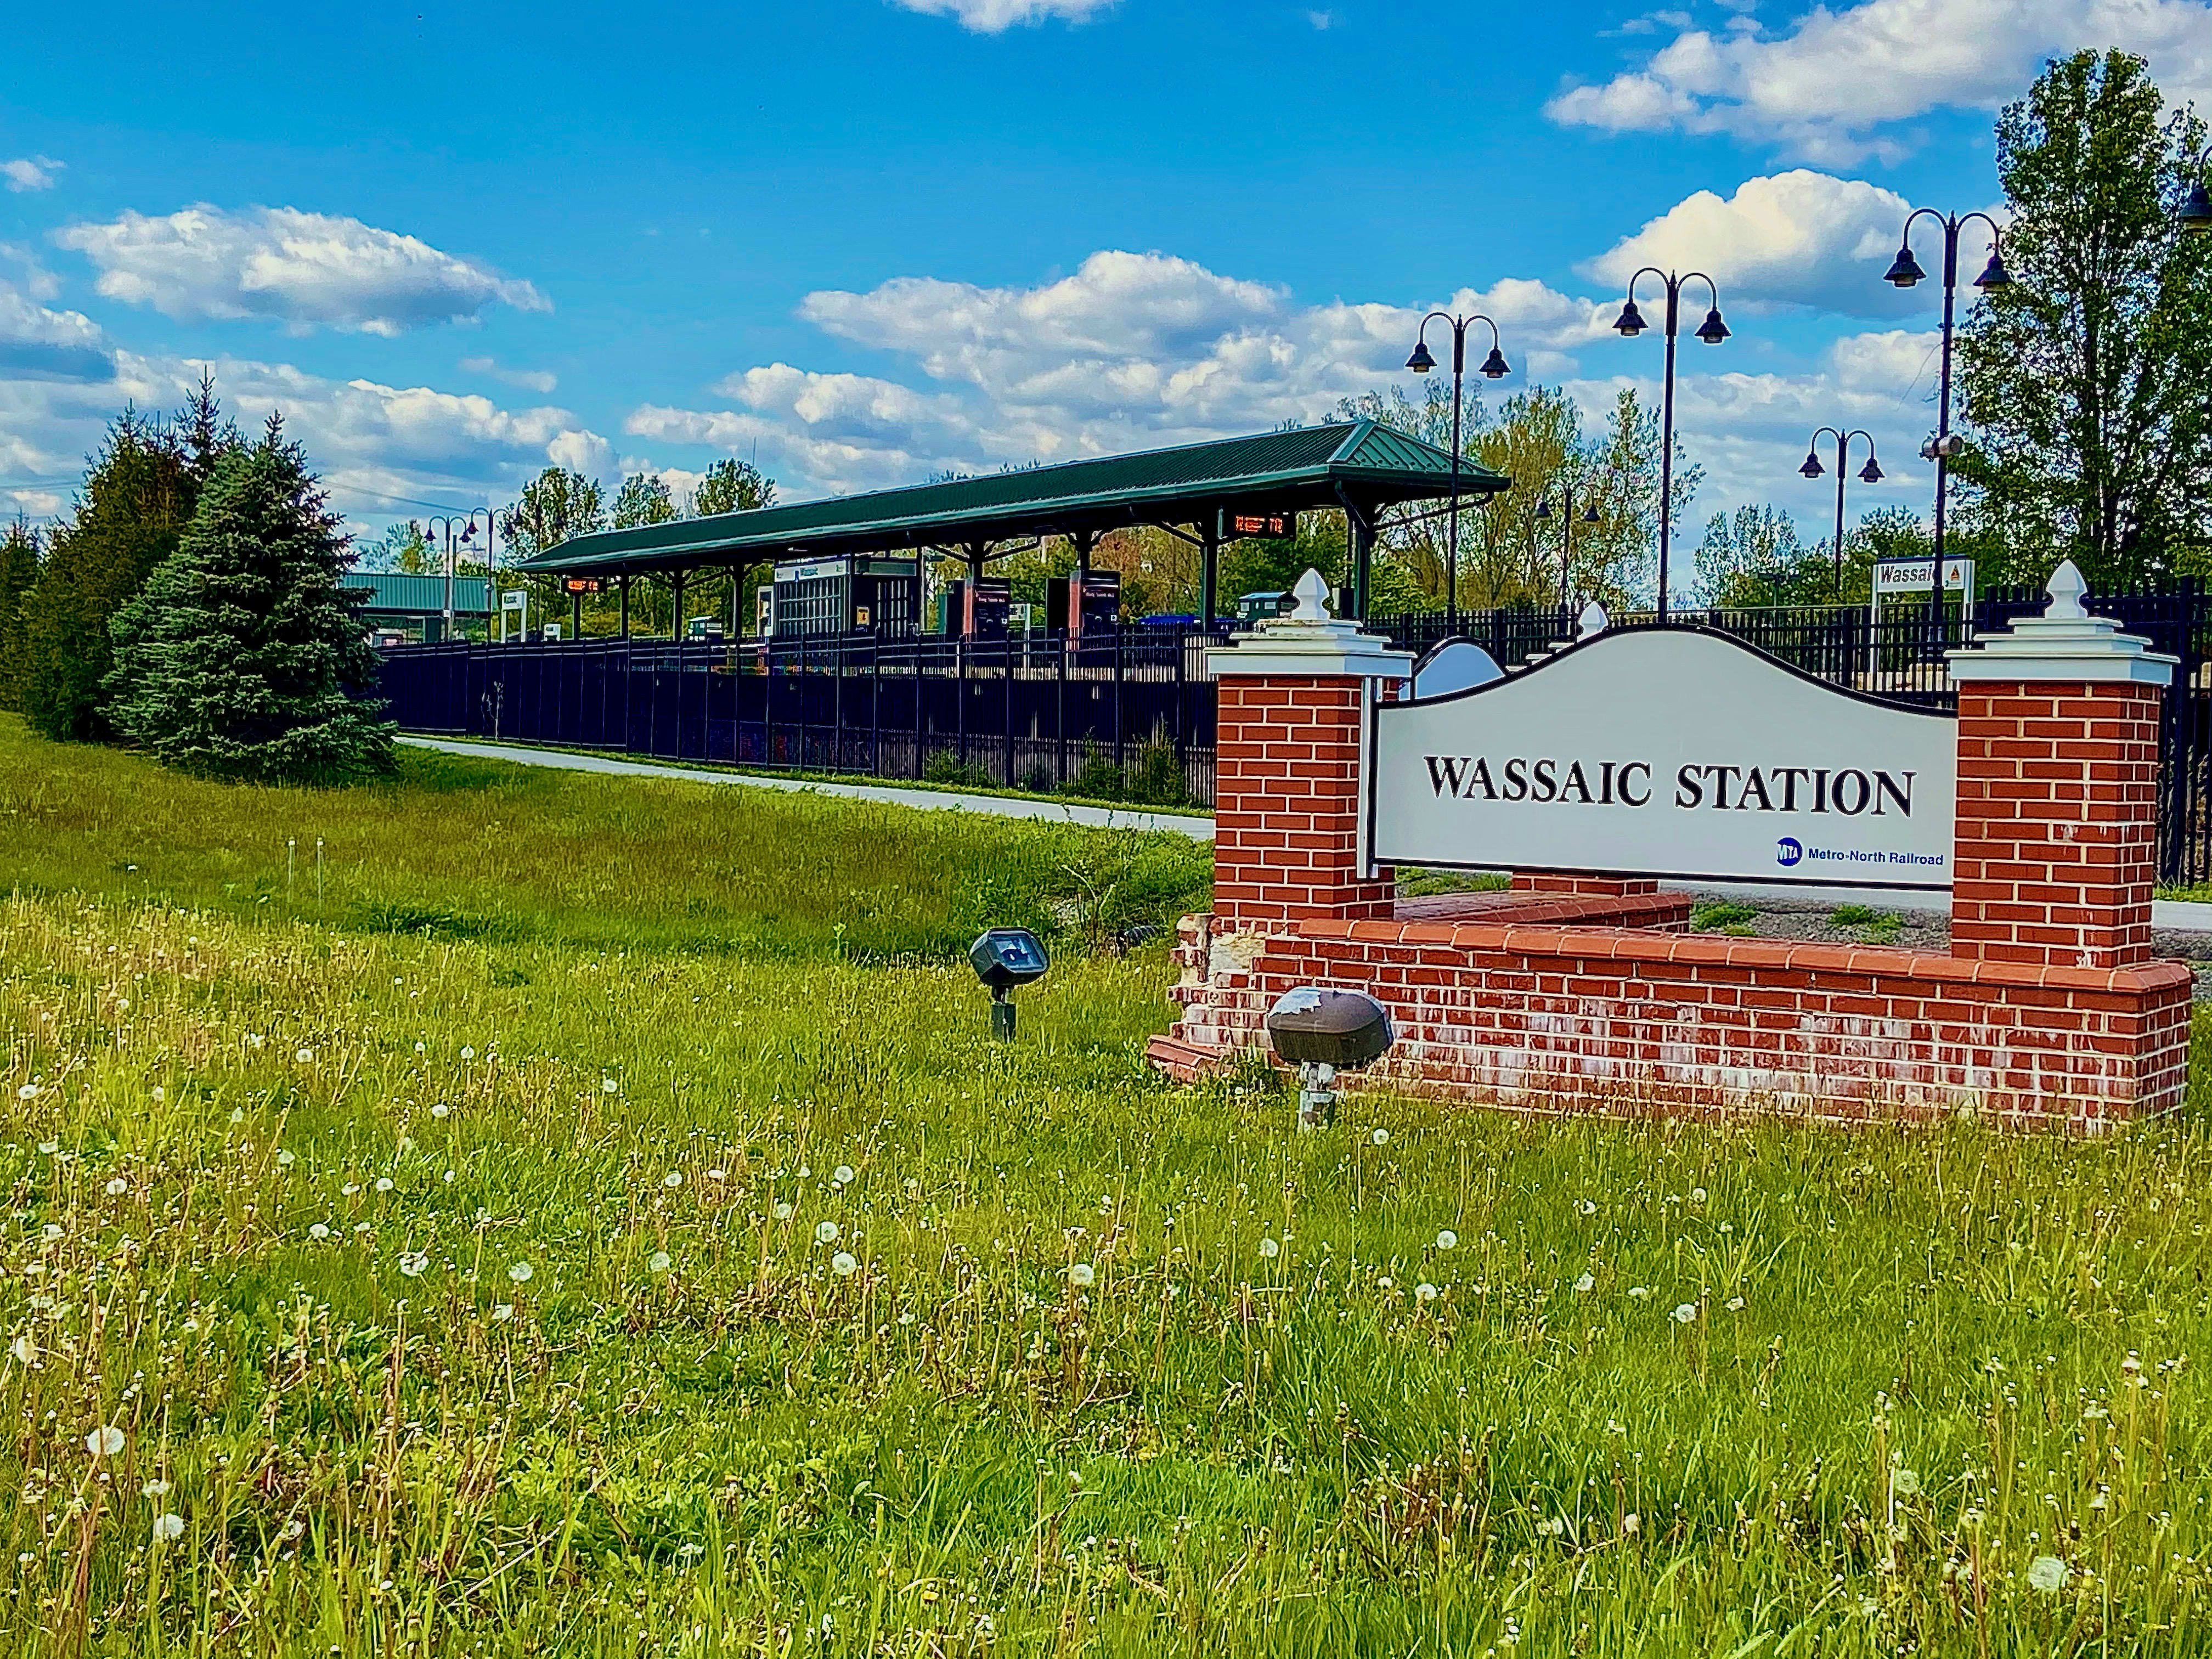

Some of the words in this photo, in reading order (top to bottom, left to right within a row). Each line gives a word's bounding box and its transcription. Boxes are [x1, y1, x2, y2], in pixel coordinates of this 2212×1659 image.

[1423, 755, 1652, 806] WASSAIC
[1675, 764, 1917, 818] STATION
[1777, 843, 1799, 861] MTA
[1808, 848, 1886, 863] Metro-North
[1889, 852, 1944, 866] Railroad
